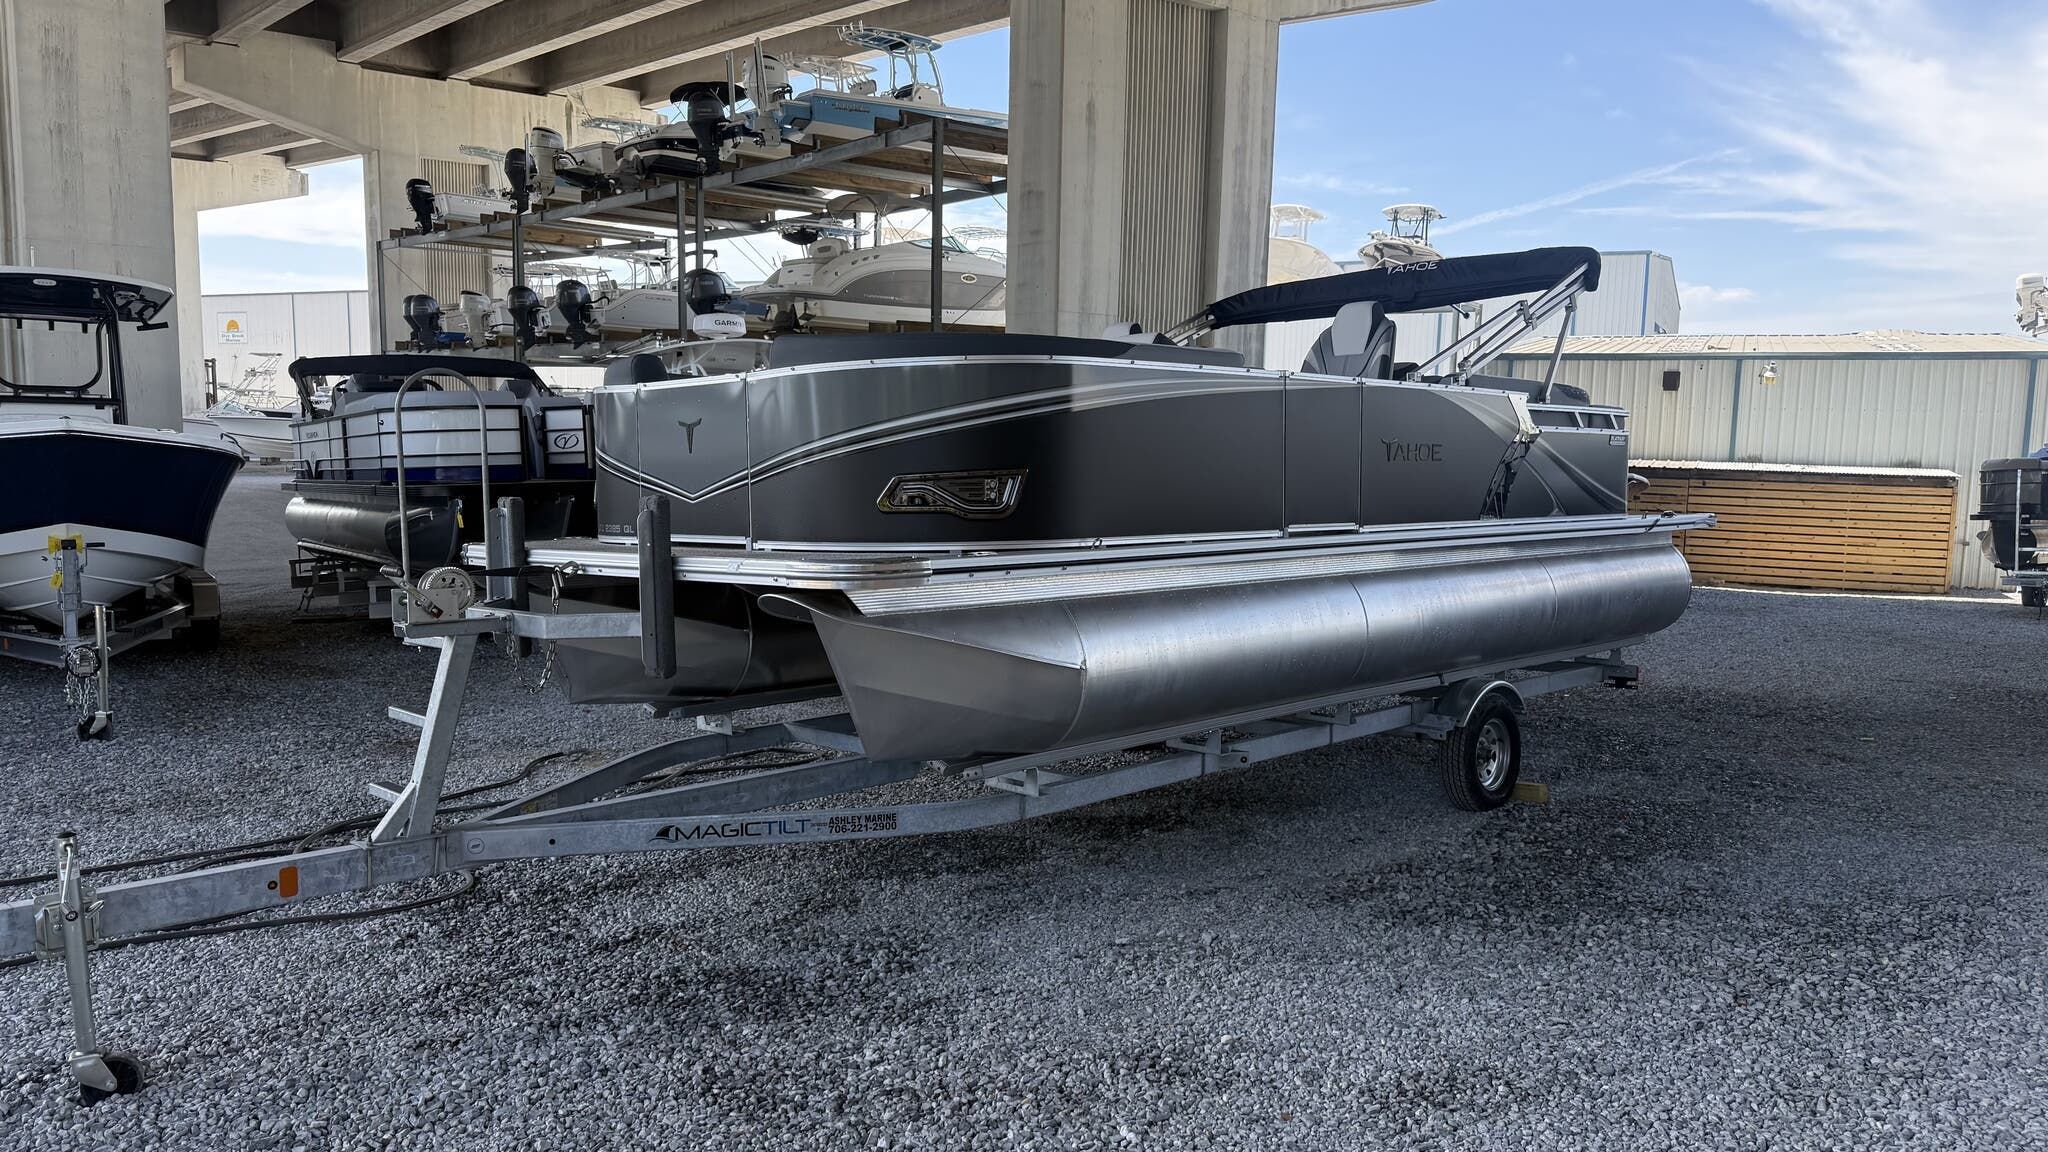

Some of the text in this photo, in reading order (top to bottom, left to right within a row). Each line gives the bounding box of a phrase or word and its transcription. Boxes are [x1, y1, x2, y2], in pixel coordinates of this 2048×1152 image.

[1385, 261, 1439, 275] TAHOE
[1380, 438, 1443, 462] TAHOE
[828, 813, 897, 825] ASHLEY MARINE
[675, 819, 811, 841] MAGICTILT
[828, 822, 897, 834] 706-221-2900
